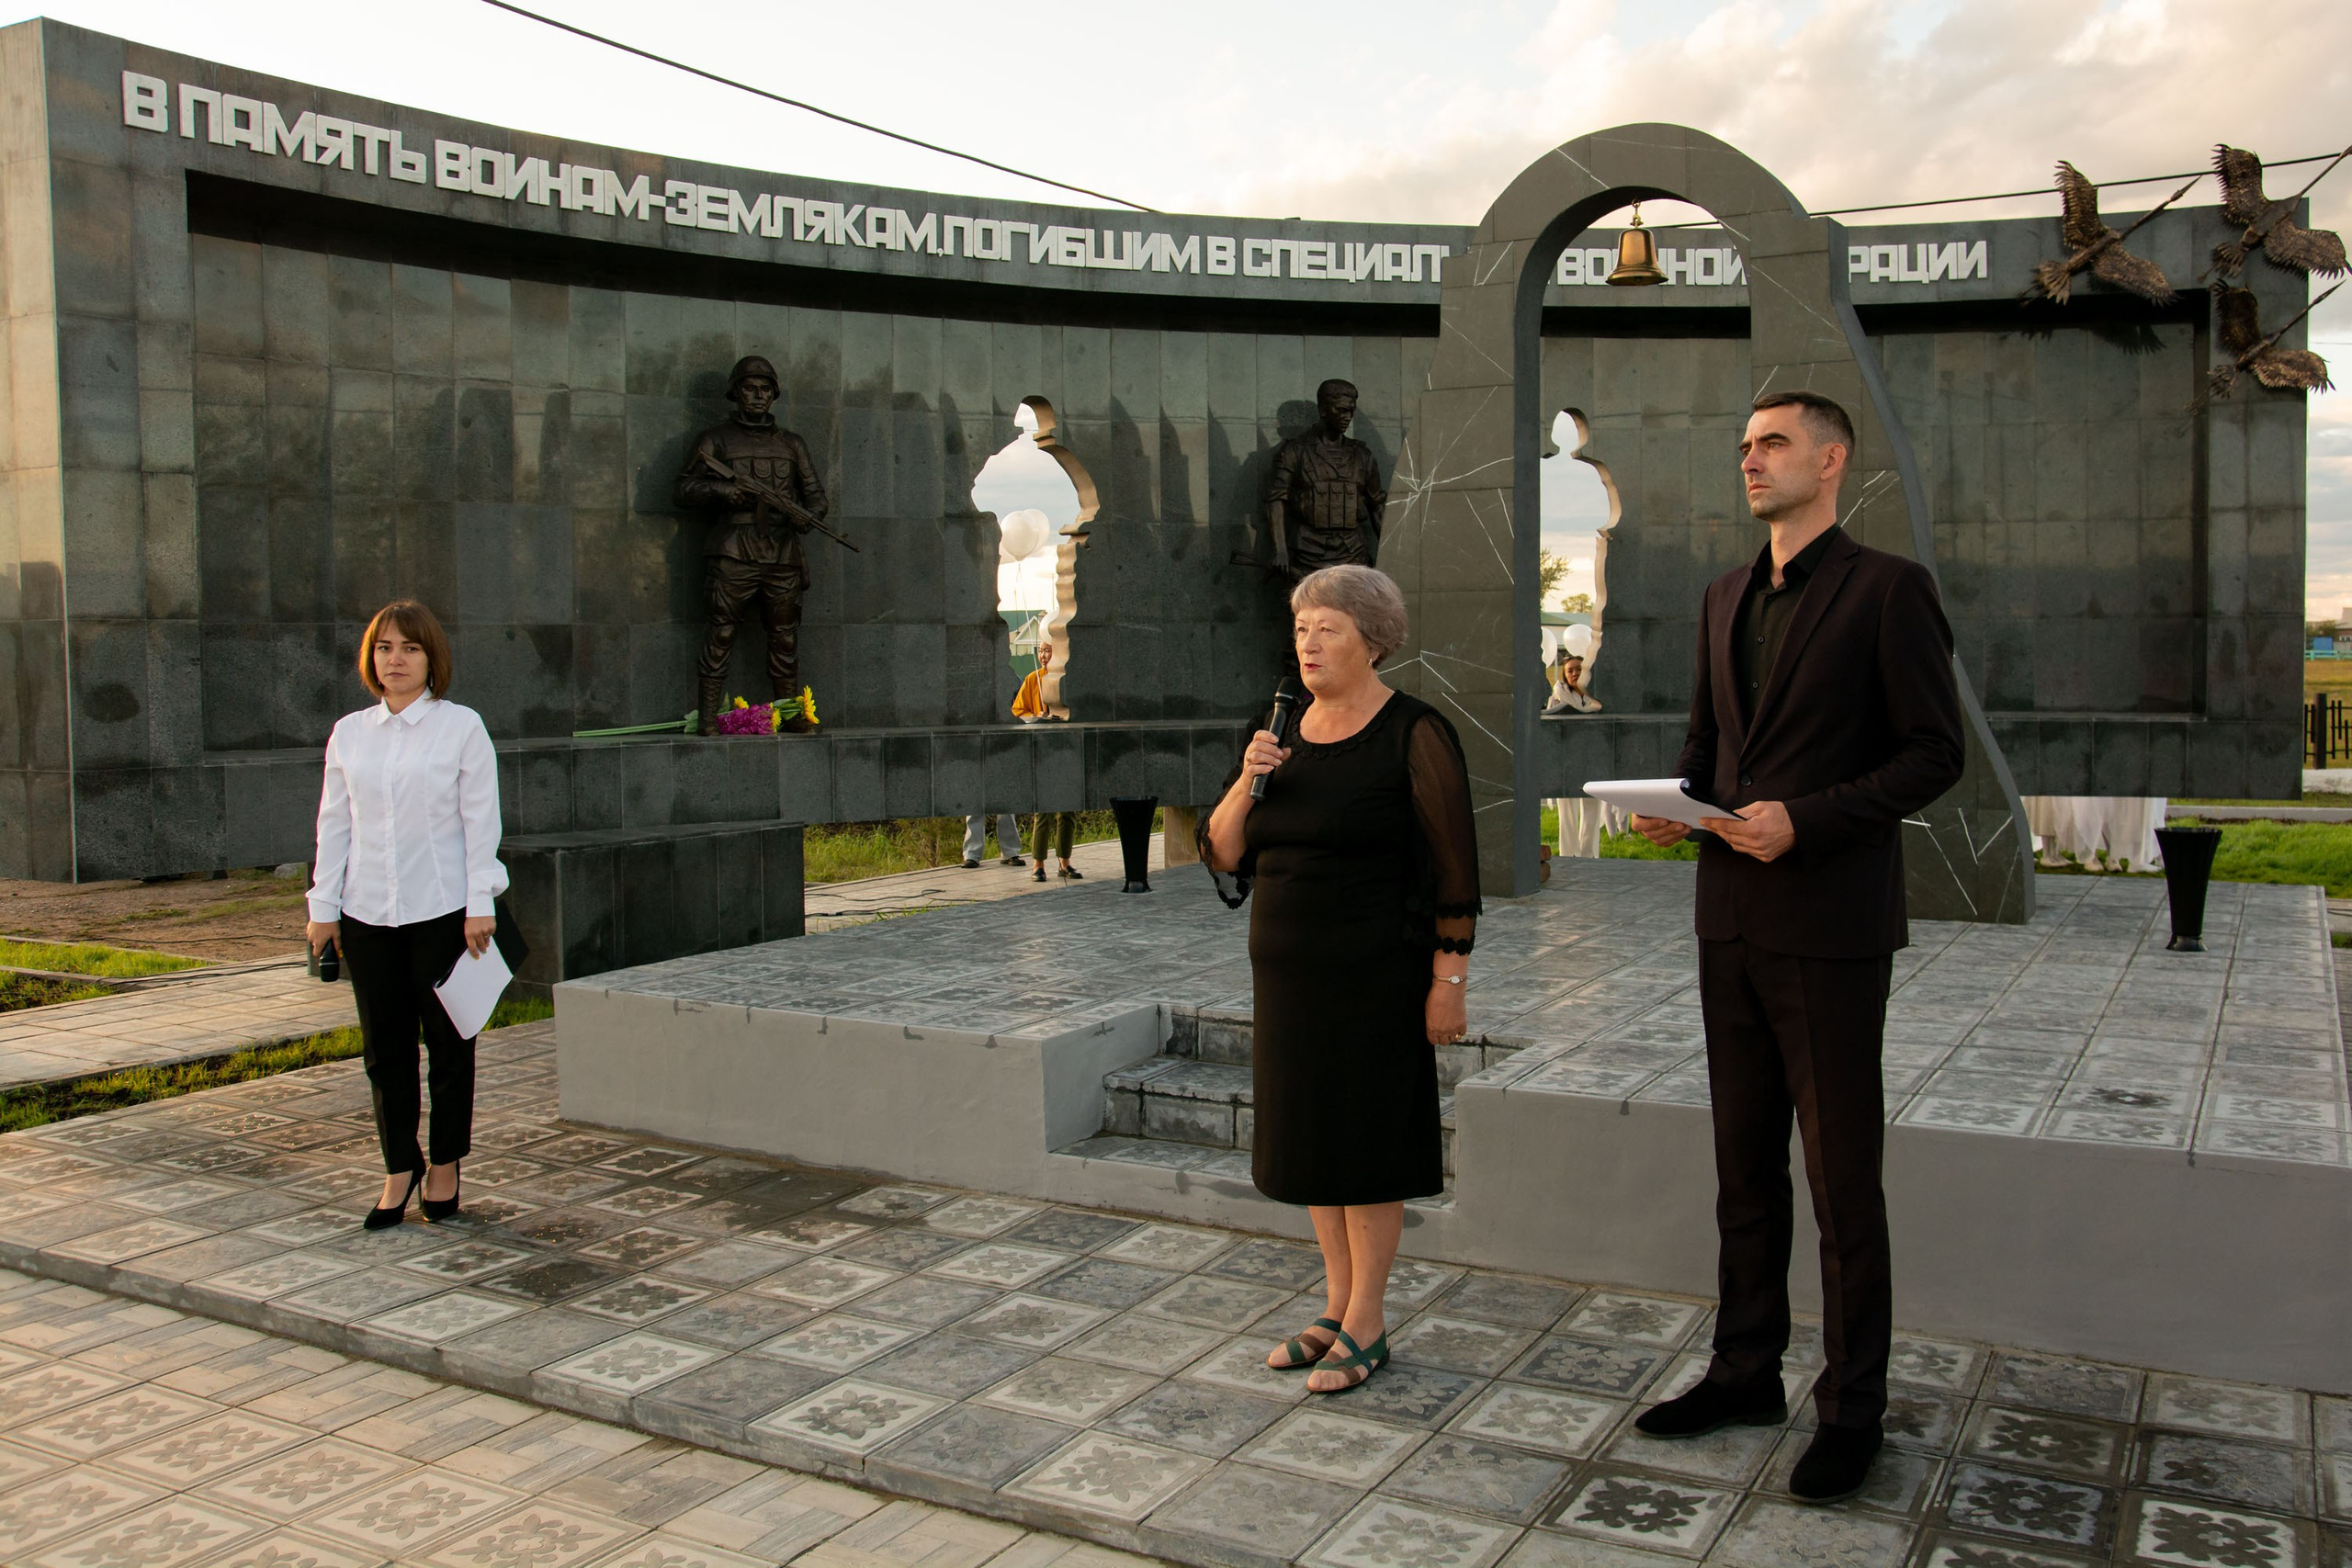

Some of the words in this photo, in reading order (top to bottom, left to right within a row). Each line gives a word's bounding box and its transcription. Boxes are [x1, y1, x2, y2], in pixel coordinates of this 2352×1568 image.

[121, 70, 168, 132] В
[178, 83, 426, 184] ПАМЯТЬ
[944, 215, 1200, 274] ПОГИБШИМ
[1206, 236, 1236, 276] В
[1242, 238, 1450, 284] СПЕЦИАЛ
[1556, 245, 1747, 286] ВОНОЙ
[1848, 240, 1988, 284] РАЦИИ
